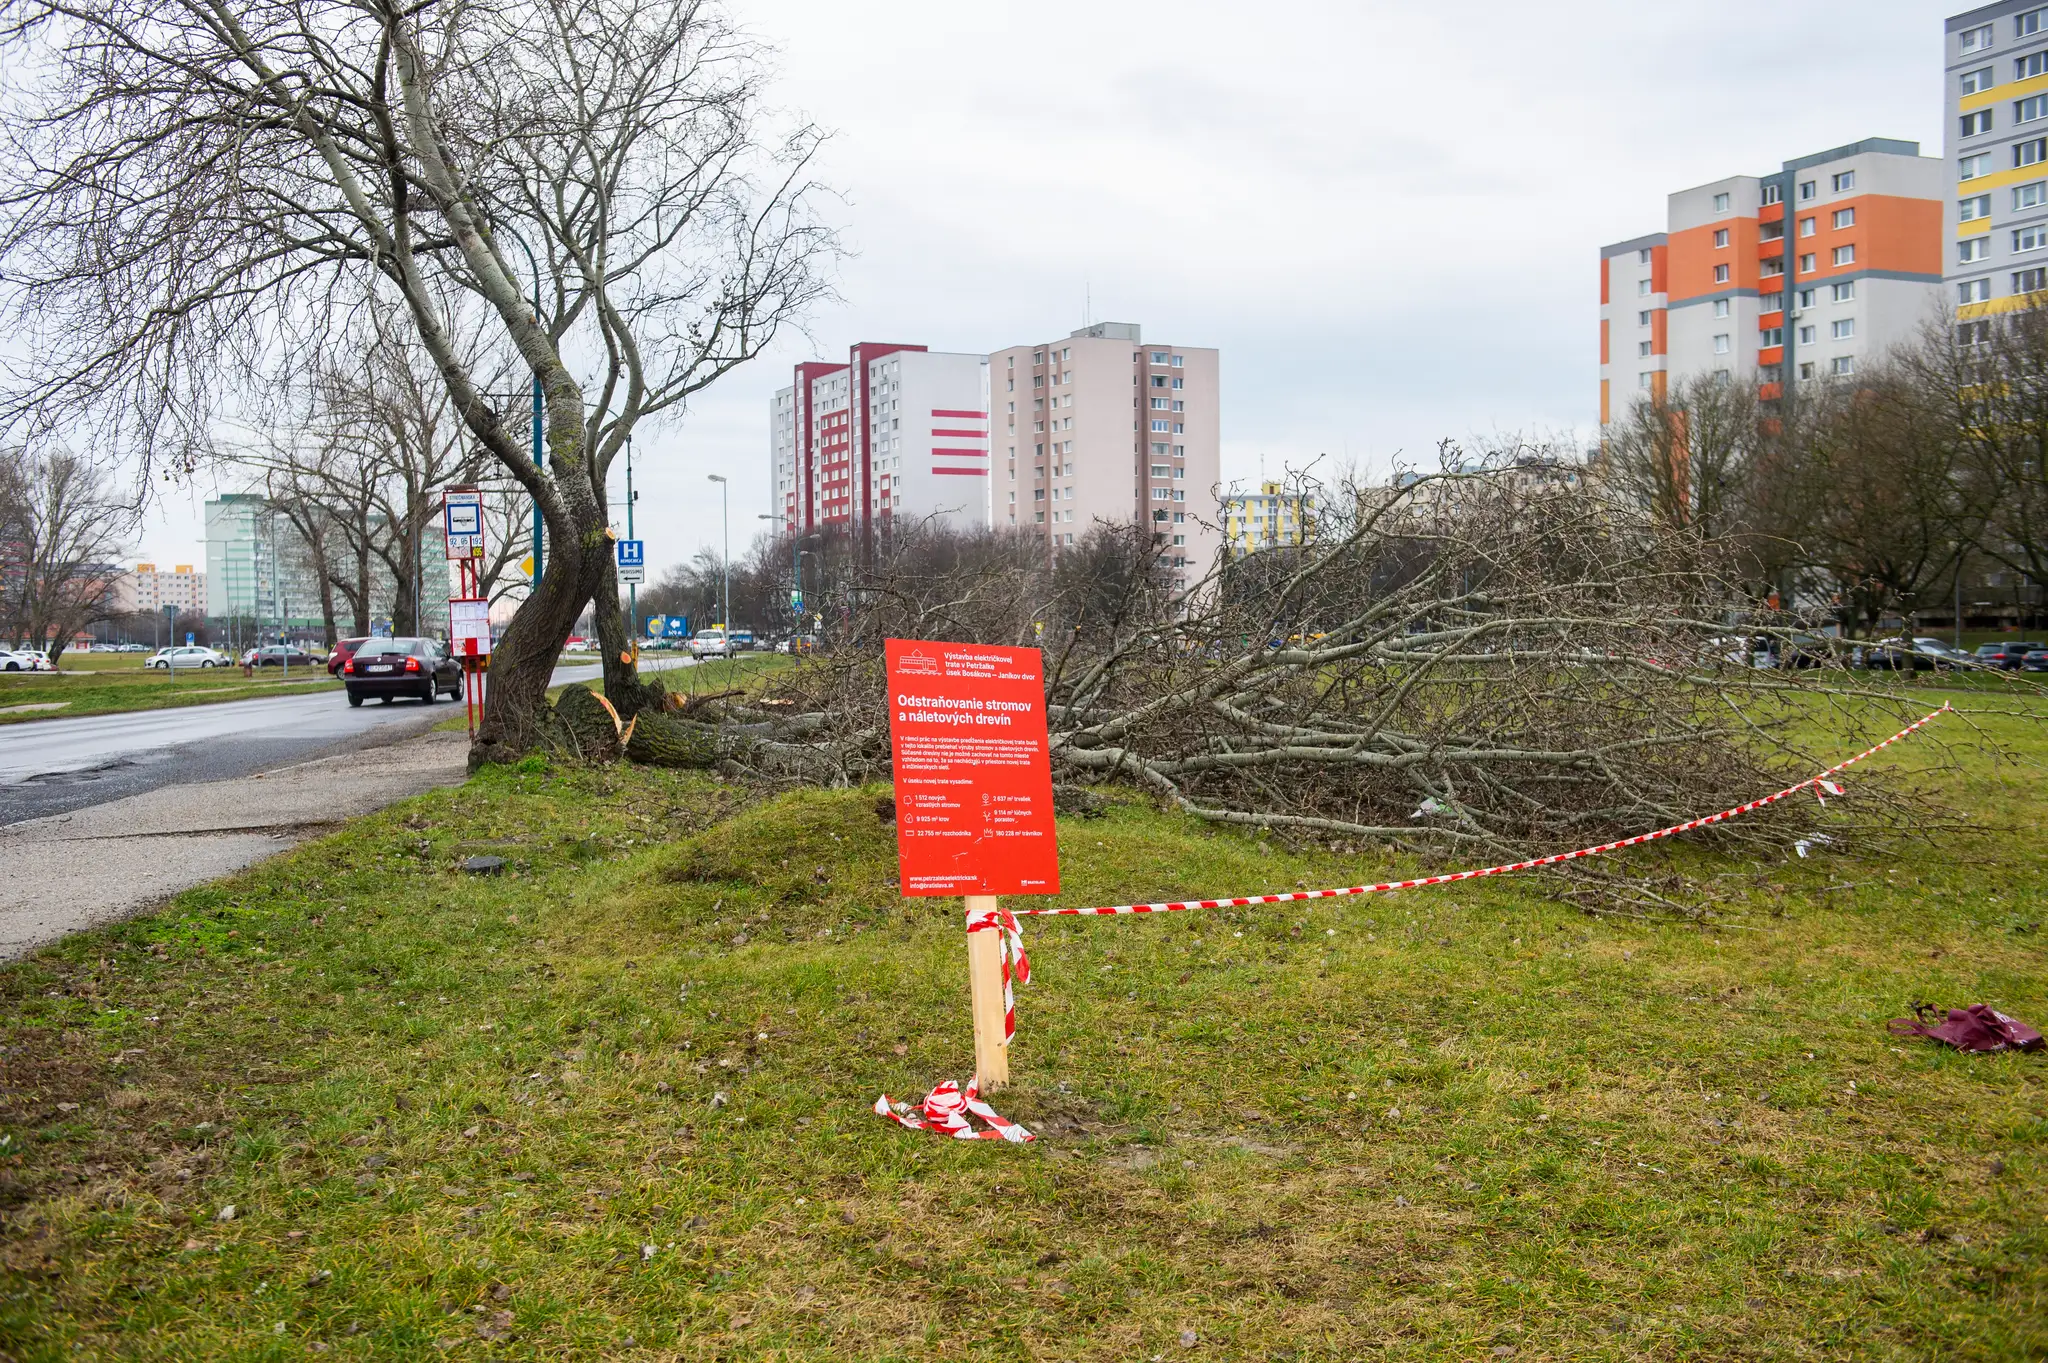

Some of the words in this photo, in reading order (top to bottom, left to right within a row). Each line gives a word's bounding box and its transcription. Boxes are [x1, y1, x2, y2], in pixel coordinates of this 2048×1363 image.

[624, 544, 638, 558] H
[944, 653, 973, 661] Výstavba
[974, 654, 1012, 664] električkovej
[898, 694, 983, 709] Odstraňovanie
[986, 700, 1032, 712] stromov
[899, 713, 906, 721] a
[909, 710, 973, 726] náletových
[976, 713, 1011, 725] drevín
